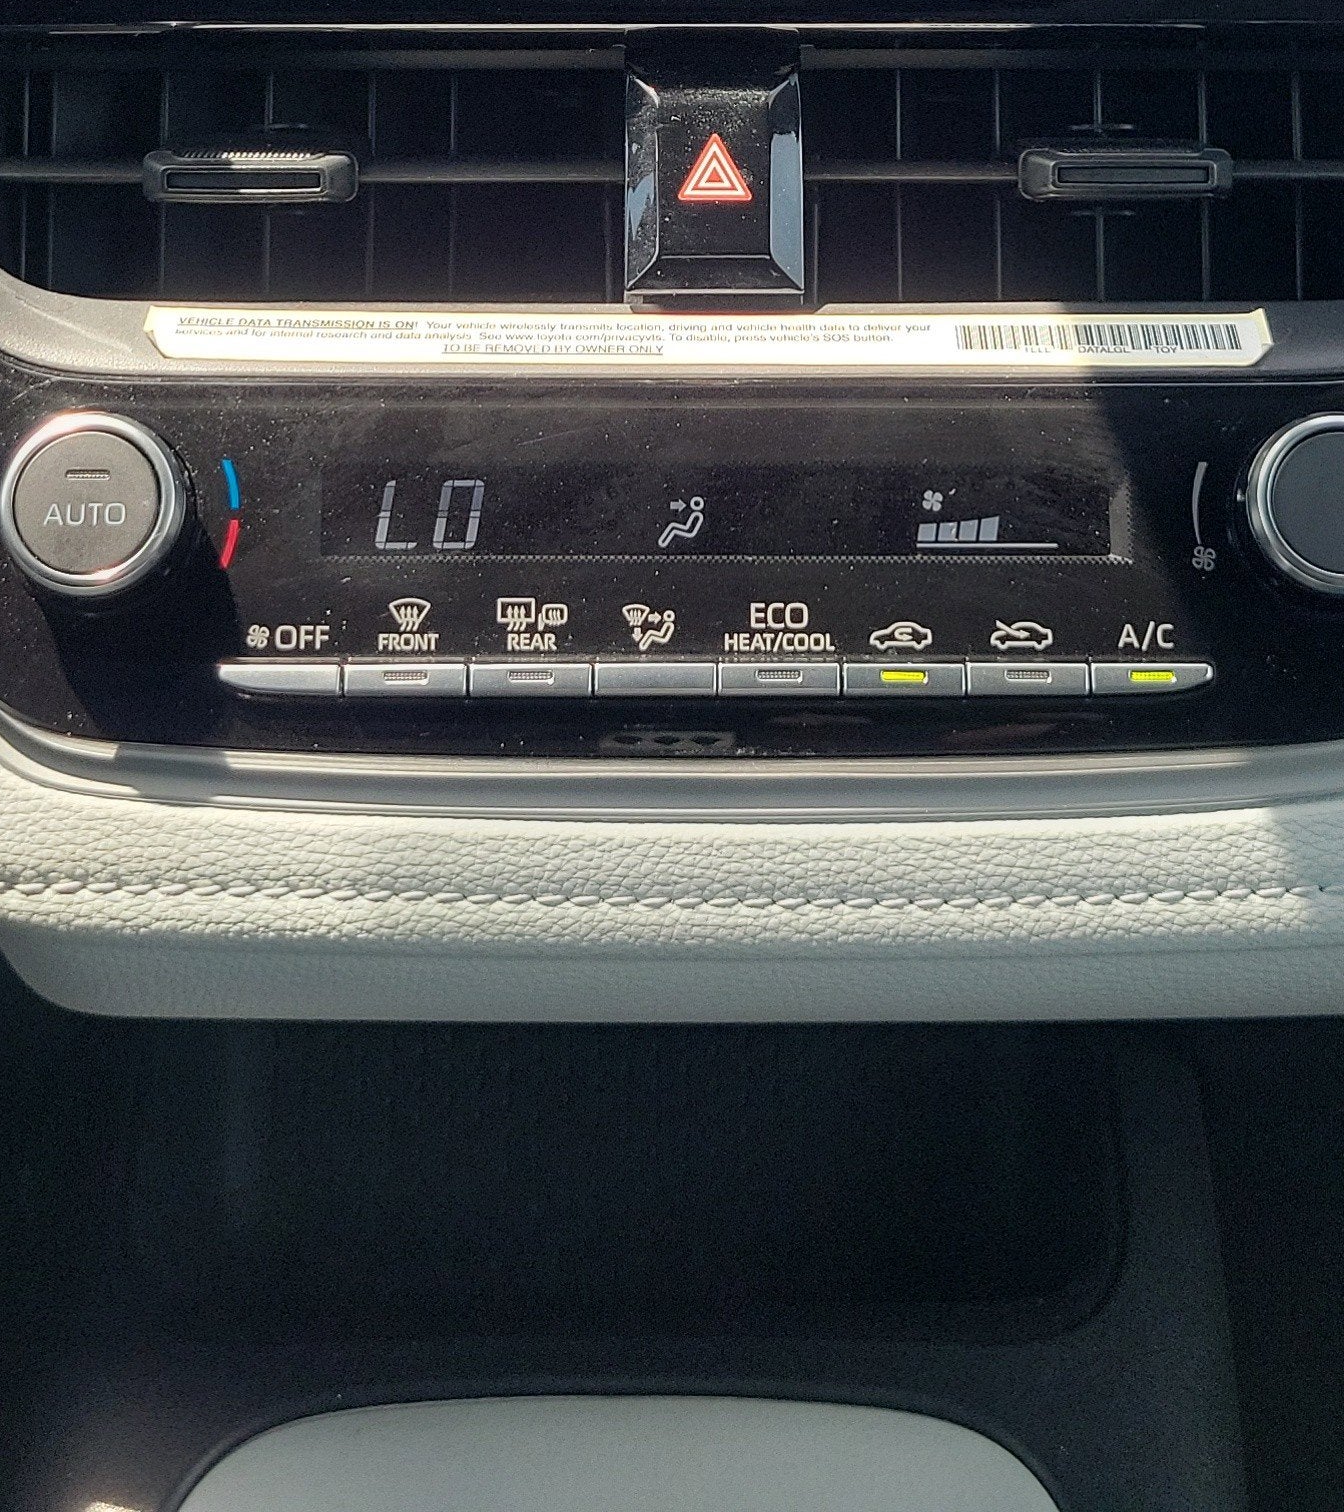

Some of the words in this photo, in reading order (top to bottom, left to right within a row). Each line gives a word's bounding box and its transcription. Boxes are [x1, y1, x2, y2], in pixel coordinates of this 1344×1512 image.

[177, 316, 235, 327] VEHICLE
[238, 317, 272, 327] DATA
[276, 318, 375, 329] TRANSMISSION
[378, 320, 392, 329] IS
[425, 320, 454, 330] Your
[668, 322, 707, 334] driving
[710, 322, 733, 332] and
[736, 322, 777, 332] vehicle
[822, 333, 850, 343] SOS
[43, 502, 127, 526] AUTO
[374, 479, 485, 550] LO
[749, 602, 808, 629] ECO
[274, 624, 330, 650] OFF
[377, 632, 439, 651] FRONT
[506, 632, 557, 651] REAR
[723, 632, 835, 652] HEAT/COOL
[1117, 621, 1174, 651] A/C
